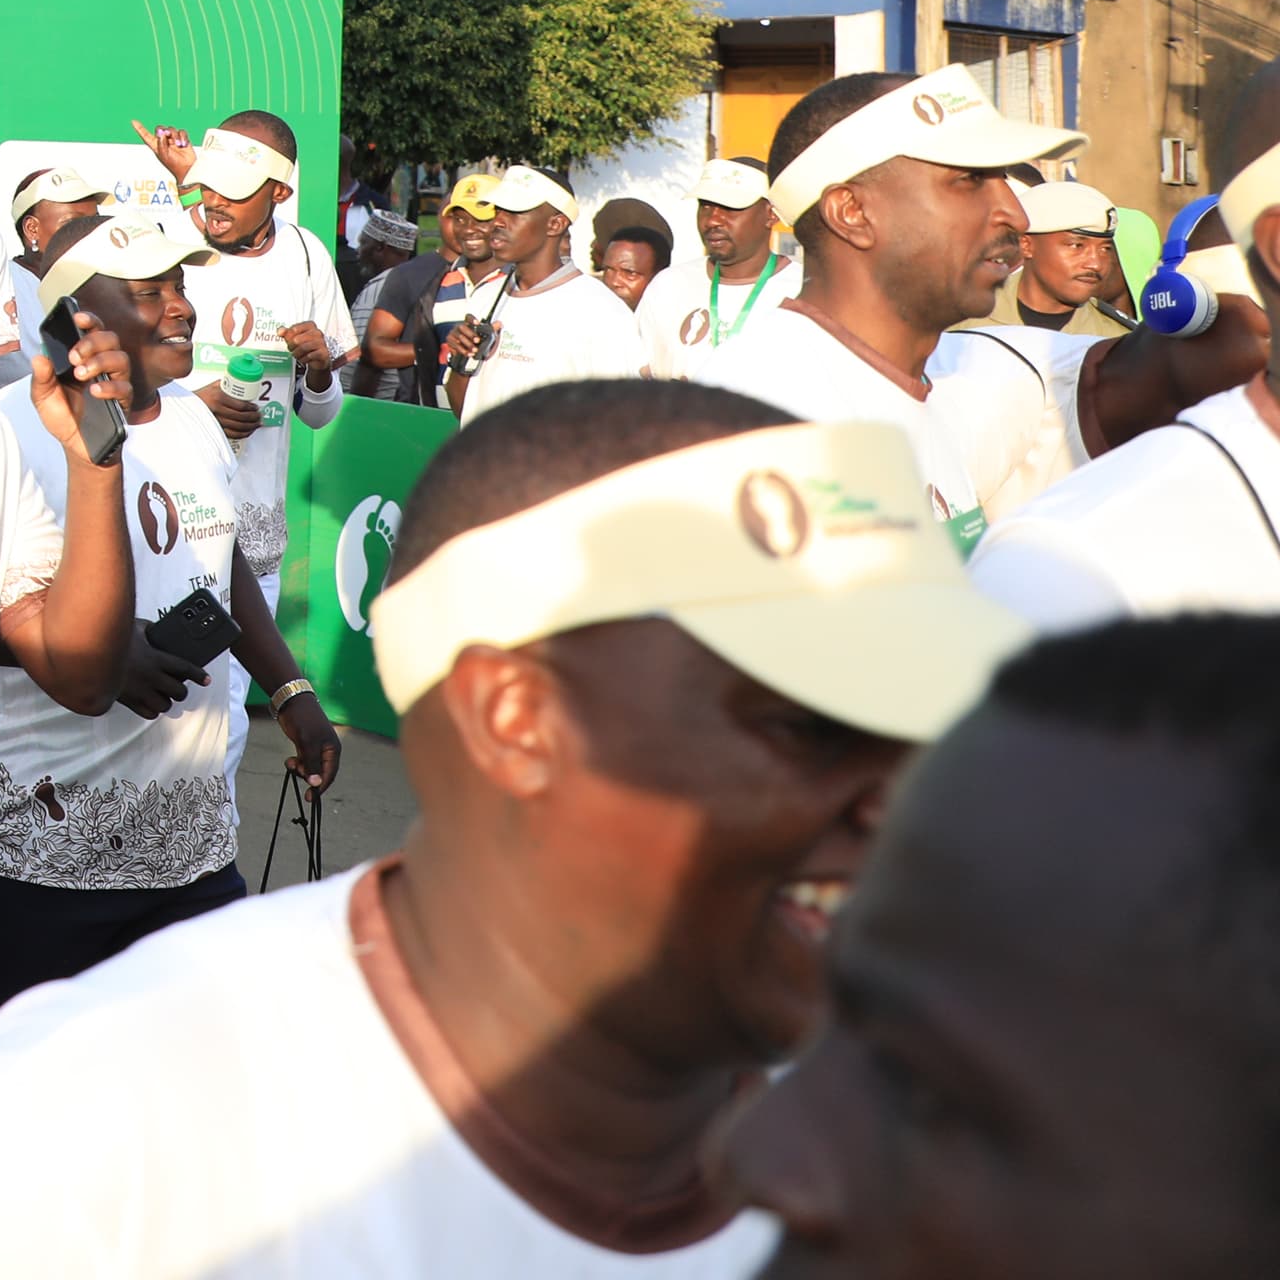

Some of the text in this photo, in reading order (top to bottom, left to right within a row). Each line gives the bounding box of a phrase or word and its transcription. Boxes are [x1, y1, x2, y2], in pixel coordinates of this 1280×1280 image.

[1149, 290, 1177, 311] JBL
[255, 306, 273, 318] The
[172, 490, 198, 507] The
[179, 505, 217, 525] Coffee
[183, 519, 235, 543] Marathon
[188, 572, 218, 592] TEAM
